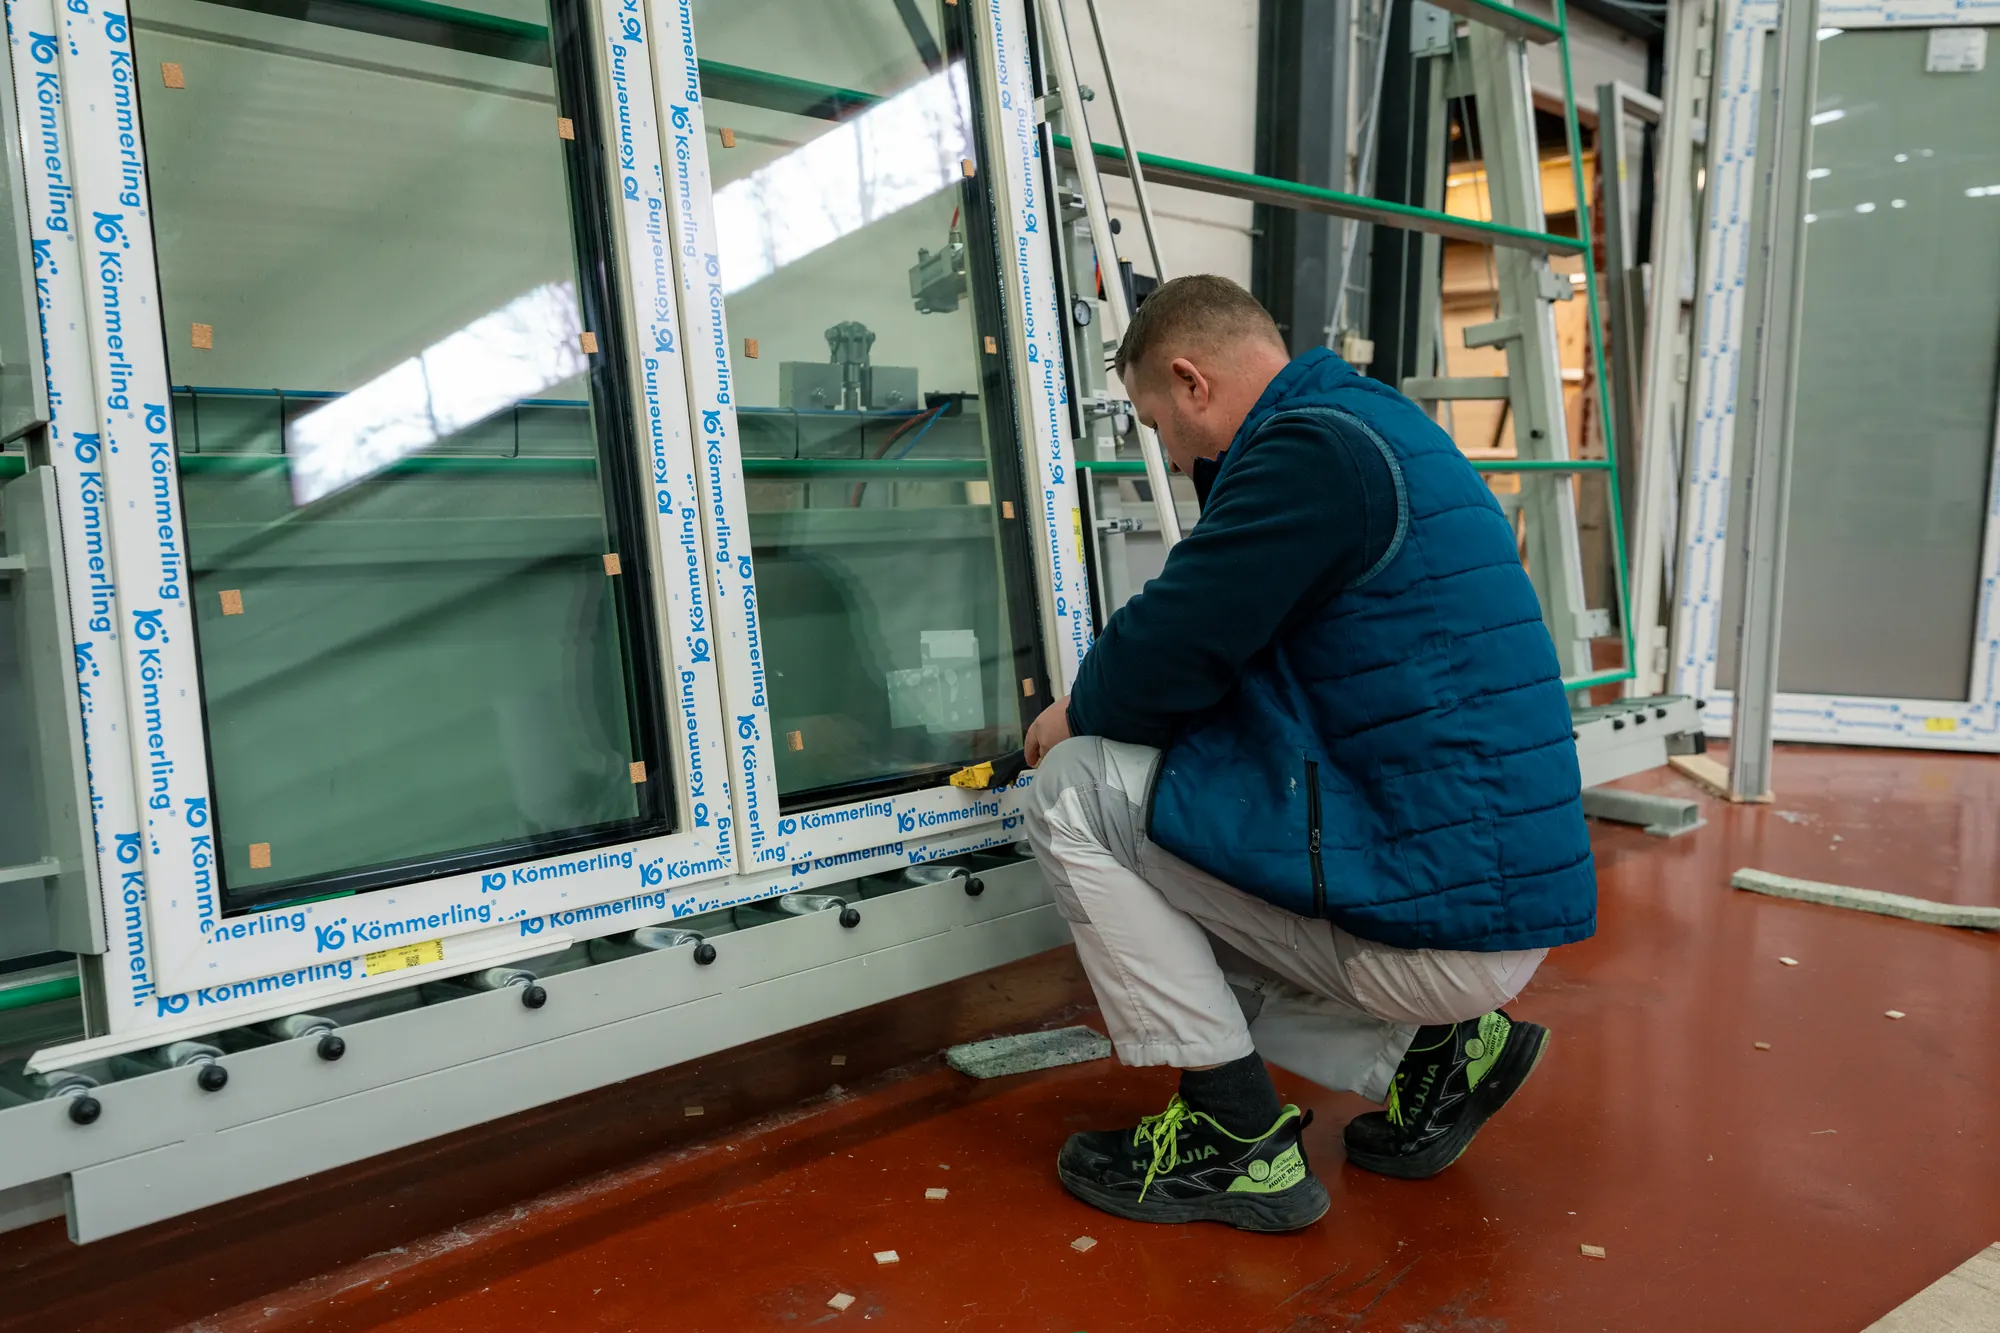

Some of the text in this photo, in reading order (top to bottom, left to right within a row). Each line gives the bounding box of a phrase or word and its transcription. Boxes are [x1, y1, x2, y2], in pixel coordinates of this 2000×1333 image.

[35, 71, 71, 232] Kömmerling
[110, 50, 144, 207] Kömmerling
[612, 44, 635, 170] Kömmerling
[1016, 108, 1036, 209] Kömmerling
[675, 136, 698, 259] Kömmerling
[647, 197, 671, 323] Kömmerling
[1018, 236, 1035, 339] Kömmerling
[99, 251, 133, 410] Kömmerling
[708, 283, 731, 405] Kömmerling
[646, 358, 669, 484] Kömmerling
[1044, 359, 1061, 461] Kömmerling
[80, 472, 115, 632] Kömmerling
[149, 442, 182, 600] Kömmerling
[707, 440, 731, 563] Kömmerling
[1045, 490, 1063, 592] Kömmerling
[681, 508, 705, 632] Kömmerling
[742, 584, 767, 708] Kömmerling
[1072, 610, 1084, 665] erling
[139, 648, 174, 812] Kömmerling
[681, 670, 704, 797] Kömmerling
[512, 849, 634, 886] Kömmerling
[800, 801, 893, 829] Kömmerling
[918, 800, 999, 828] Kömmerling
[352, 902, 492, 944] Kömmerling
